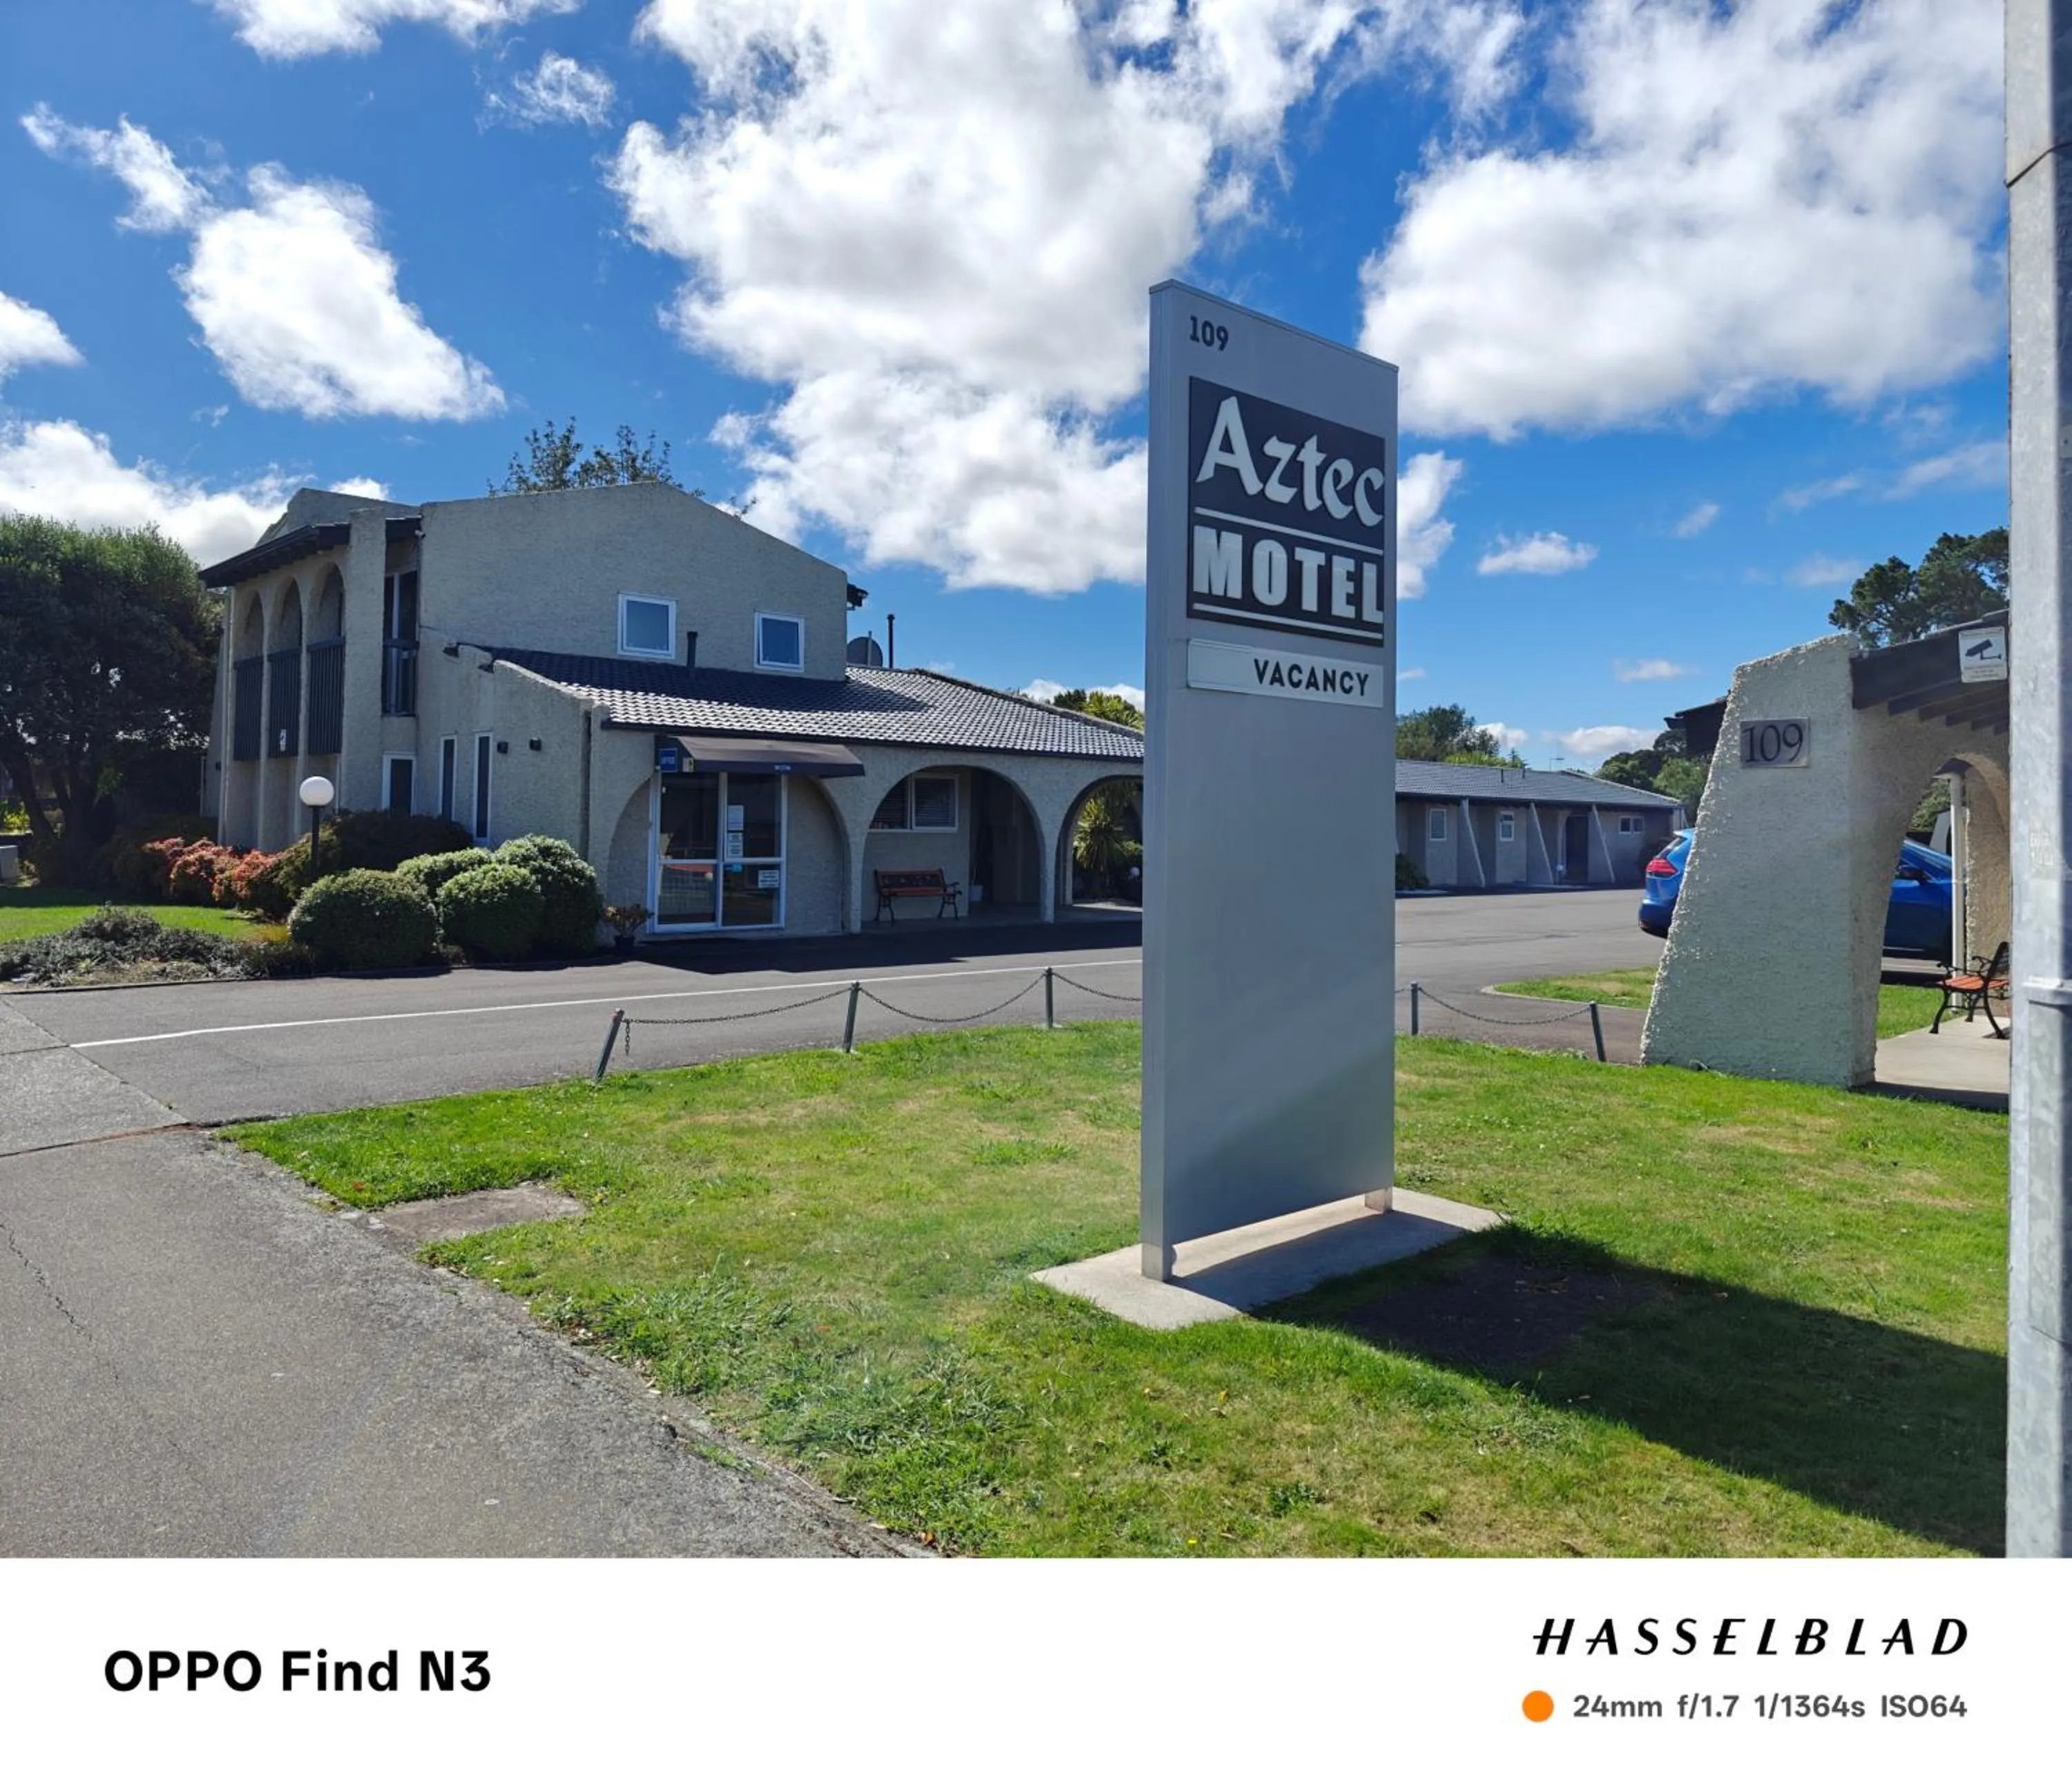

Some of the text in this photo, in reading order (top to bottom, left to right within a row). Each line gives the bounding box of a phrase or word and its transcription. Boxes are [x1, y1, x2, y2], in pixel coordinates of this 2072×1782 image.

[1189, 316, 1229, 351] 109
[1195, 396, 1385, 527] Aztec
[1193, 525, 1384, 624] MOTEL
[1254, 658, 1369, 696] VACANCY
[1742, 723, 1803, 763] 109
